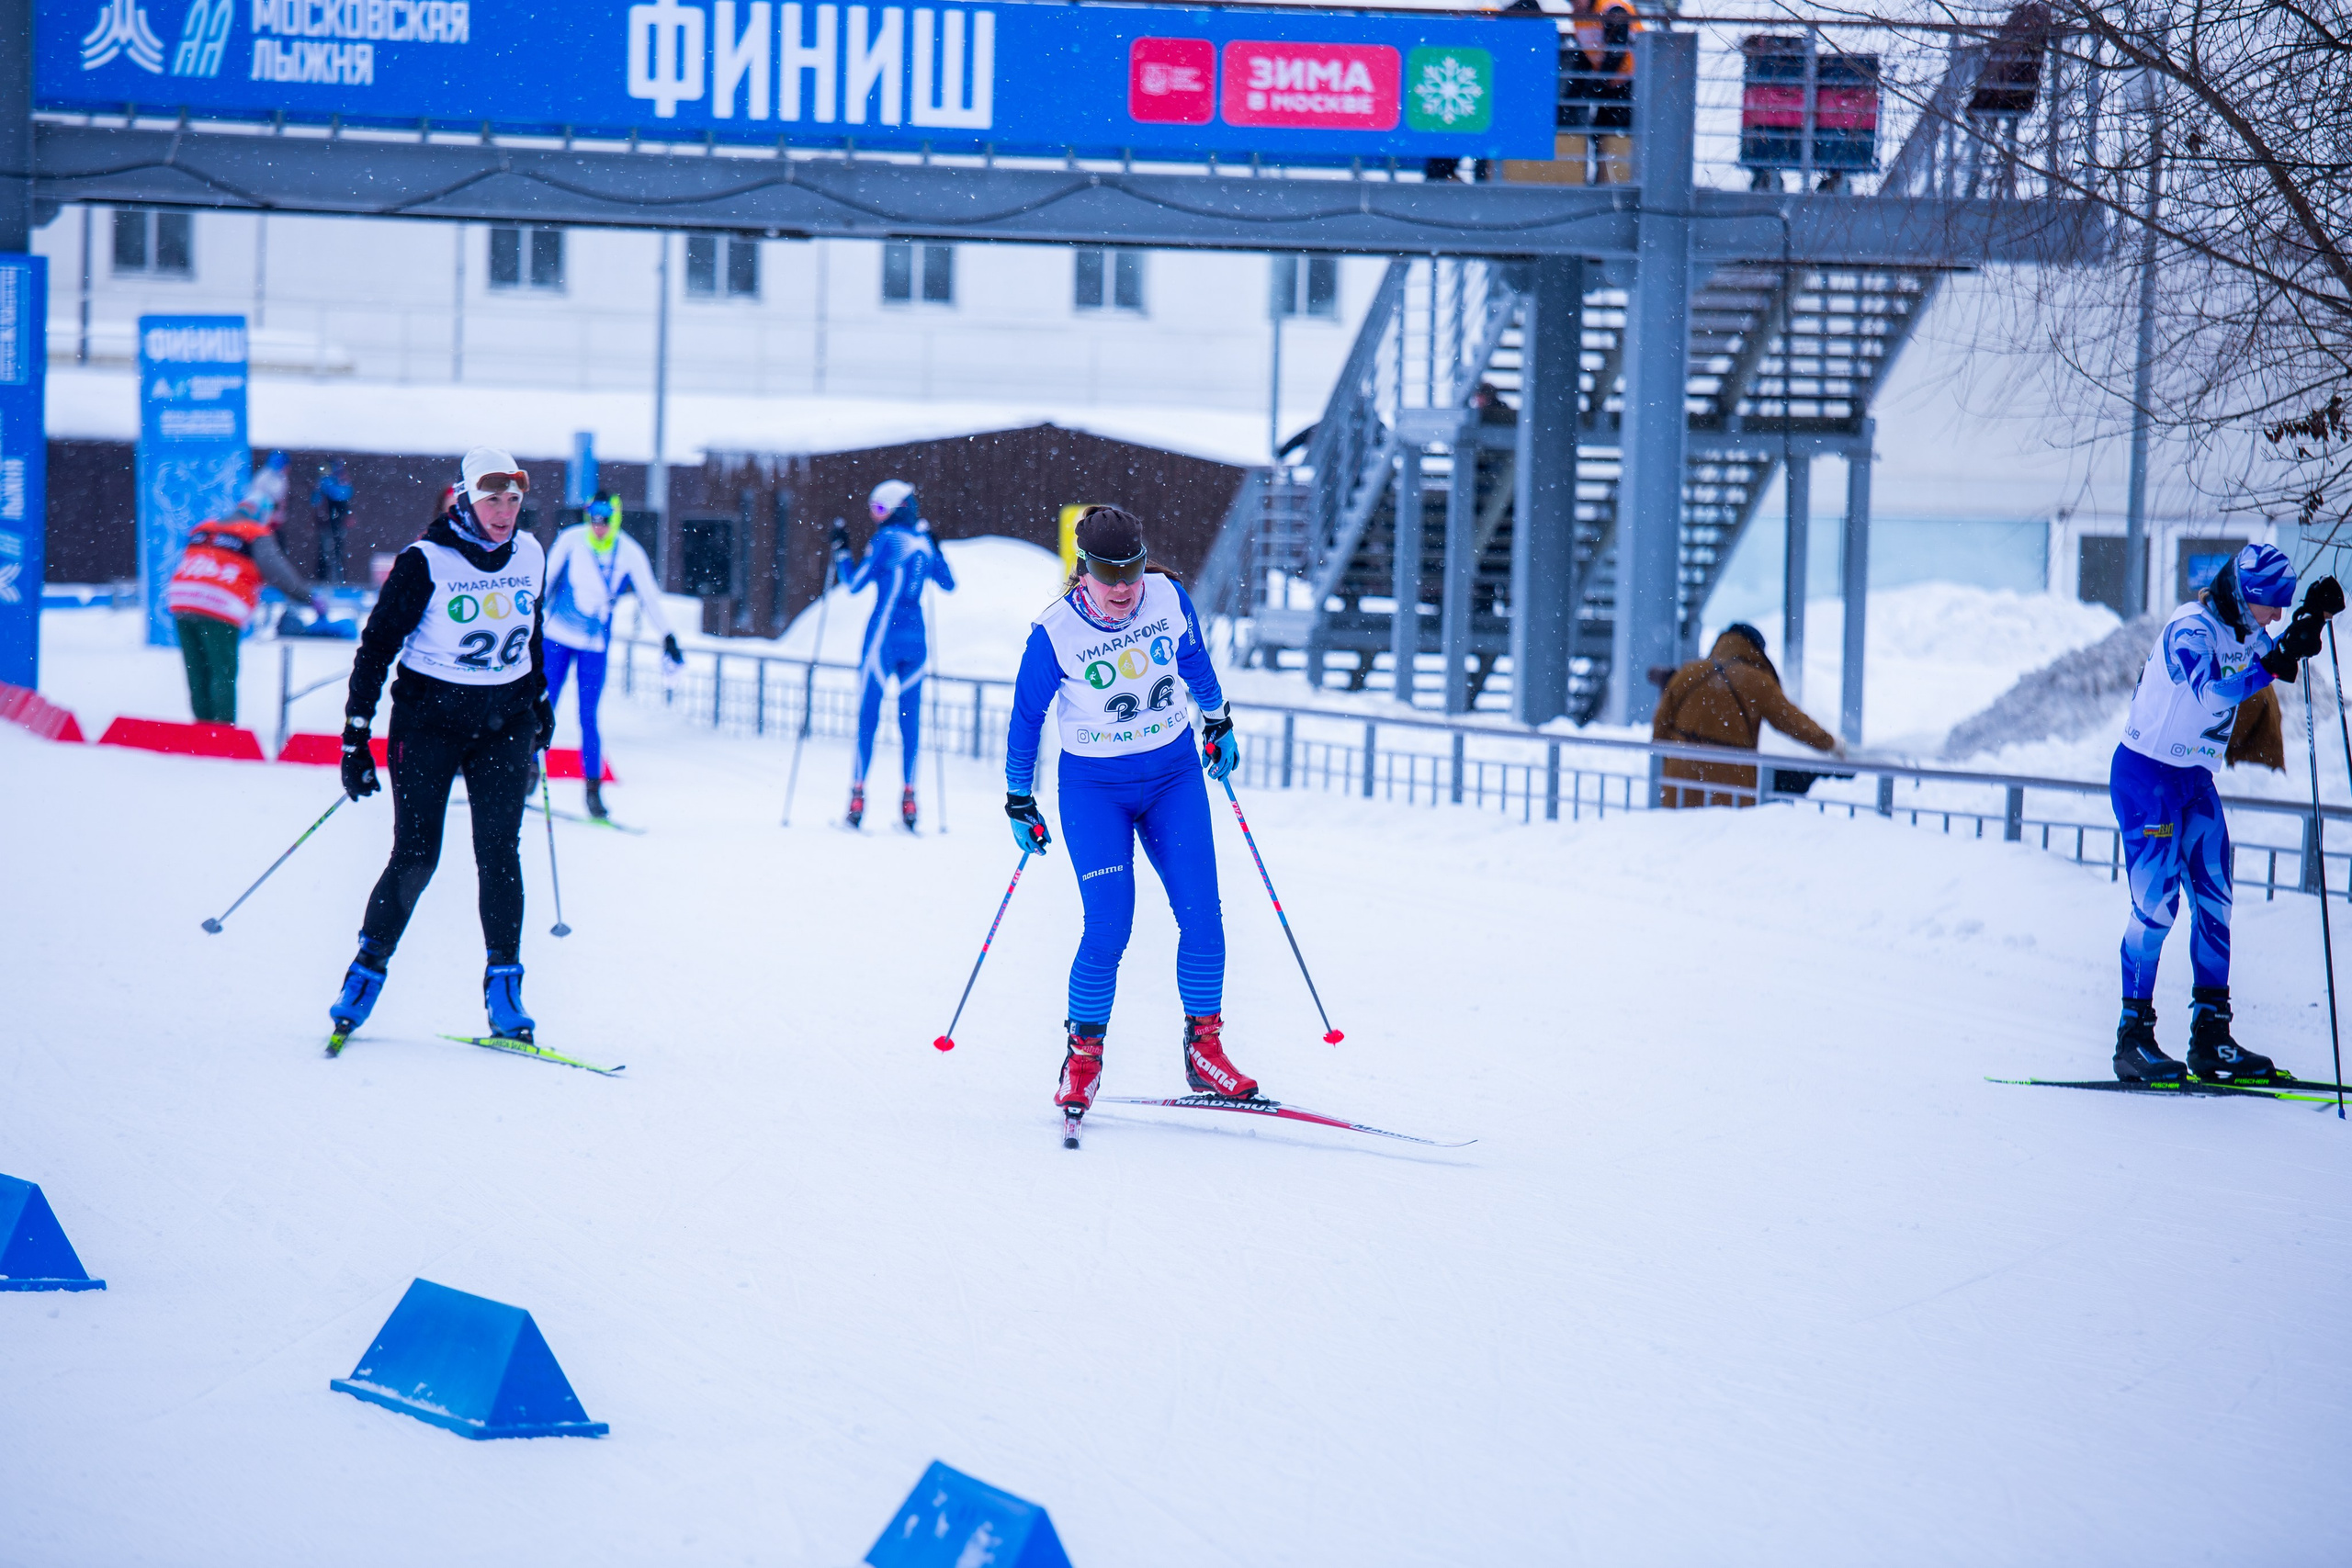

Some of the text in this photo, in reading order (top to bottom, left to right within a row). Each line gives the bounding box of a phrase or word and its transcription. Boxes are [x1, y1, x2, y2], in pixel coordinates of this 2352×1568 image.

[251, 0, 469, 43] МОСКОВСКАЯ
[250, 39, 375, 85] ЛЫЖНЯ
[628, 0, 995, 130] ФИНИШ
[1247, 55, 1375, 93] ЗИМА
[1247, 91, 1376, 115] В МОСКВЕ
[144, 326, 244, 364] ФИНИШ
[447, 575, 533, 593] VMARAFONE
[454, 624, 530, 669] 26
[1075, 617, 1170, 663] VMARAFONE
[1081, 864, 1124, 882] noname
[1188, 1043, 1238, 1092] alpina
[1173, 1098, 1279, 1114] MADSHUS
